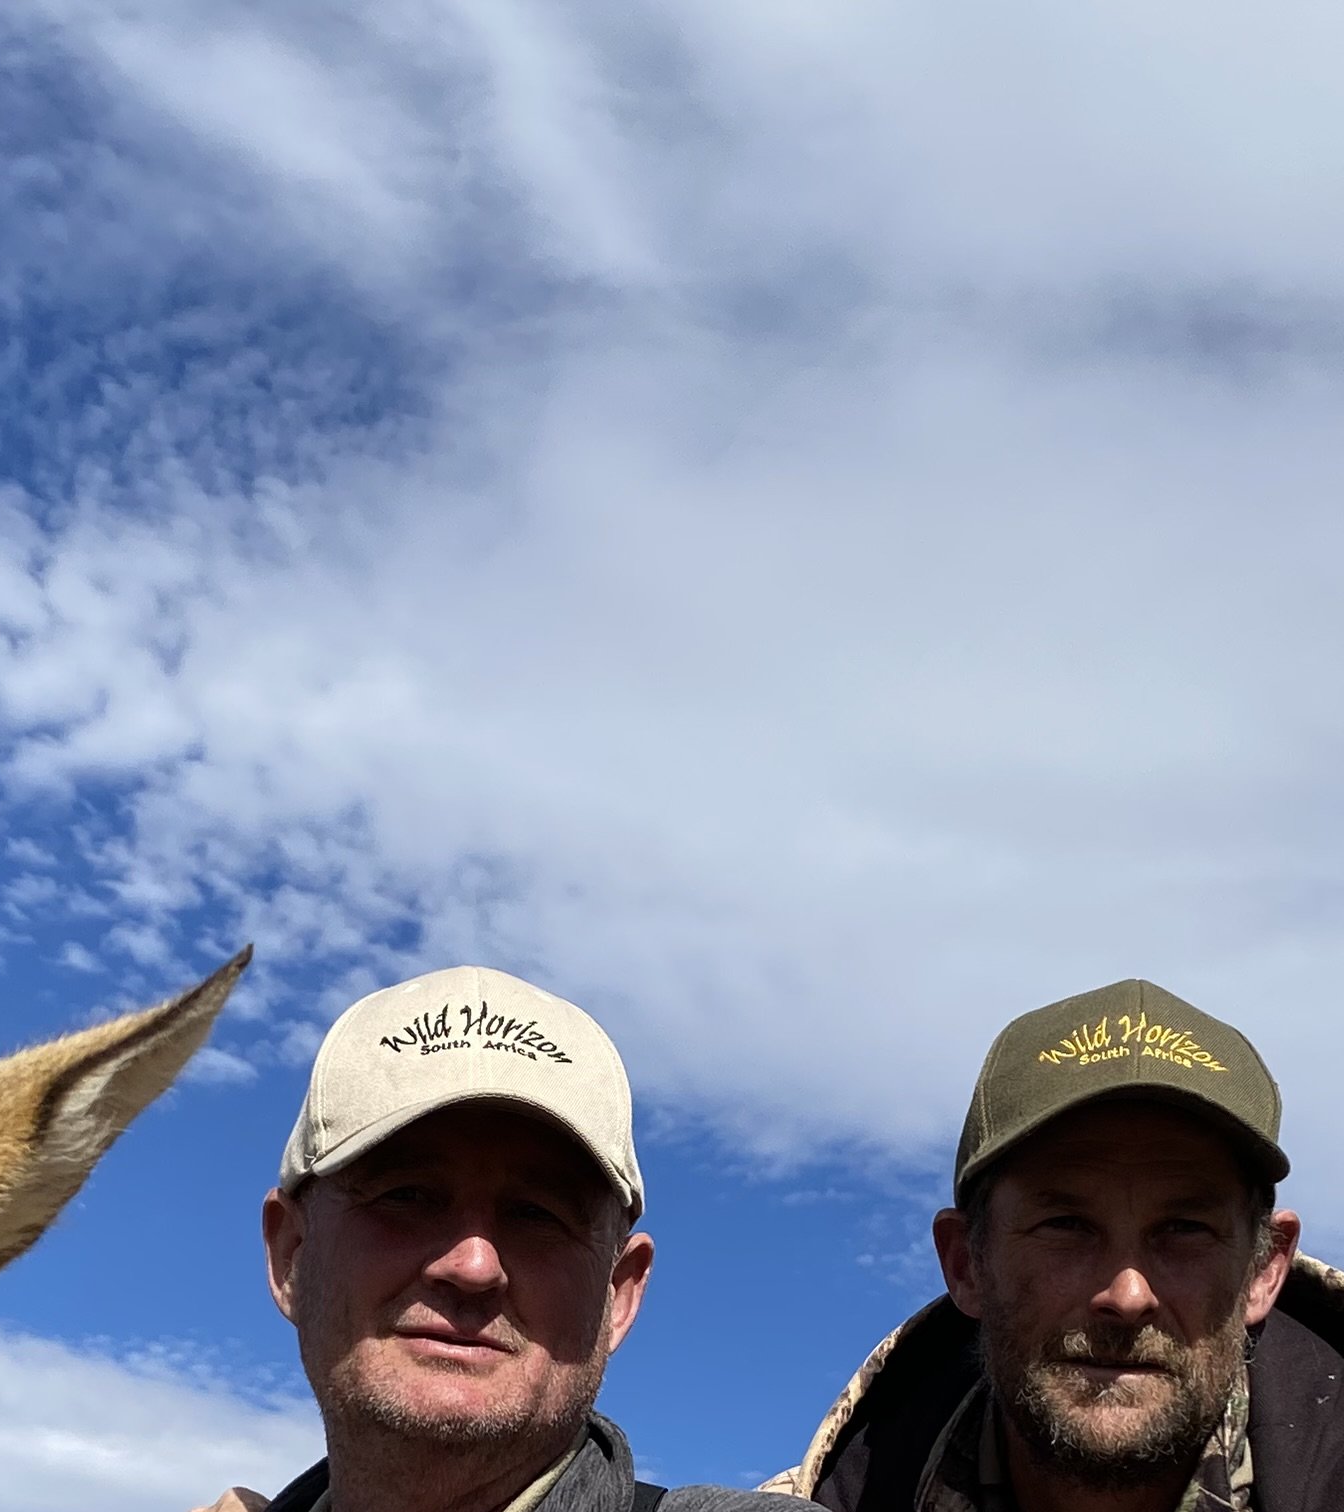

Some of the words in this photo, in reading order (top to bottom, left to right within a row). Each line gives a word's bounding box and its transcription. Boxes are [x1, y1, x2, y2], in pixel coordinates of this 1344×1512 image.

[379, 1003, 452, 1053] Wild
[460, 1000, 573, 1064] Horizon
[420, 1039, 471, 1056] South
[483, 1040, 537, 1060] Africa
[1038, 1016, 1111, 1065] Wild
[1118, 1012, 1229, 1072] Horizon
[1079, 1046, 1130, 1065] South
[1141, 1046, 1193, 1069] Africa
